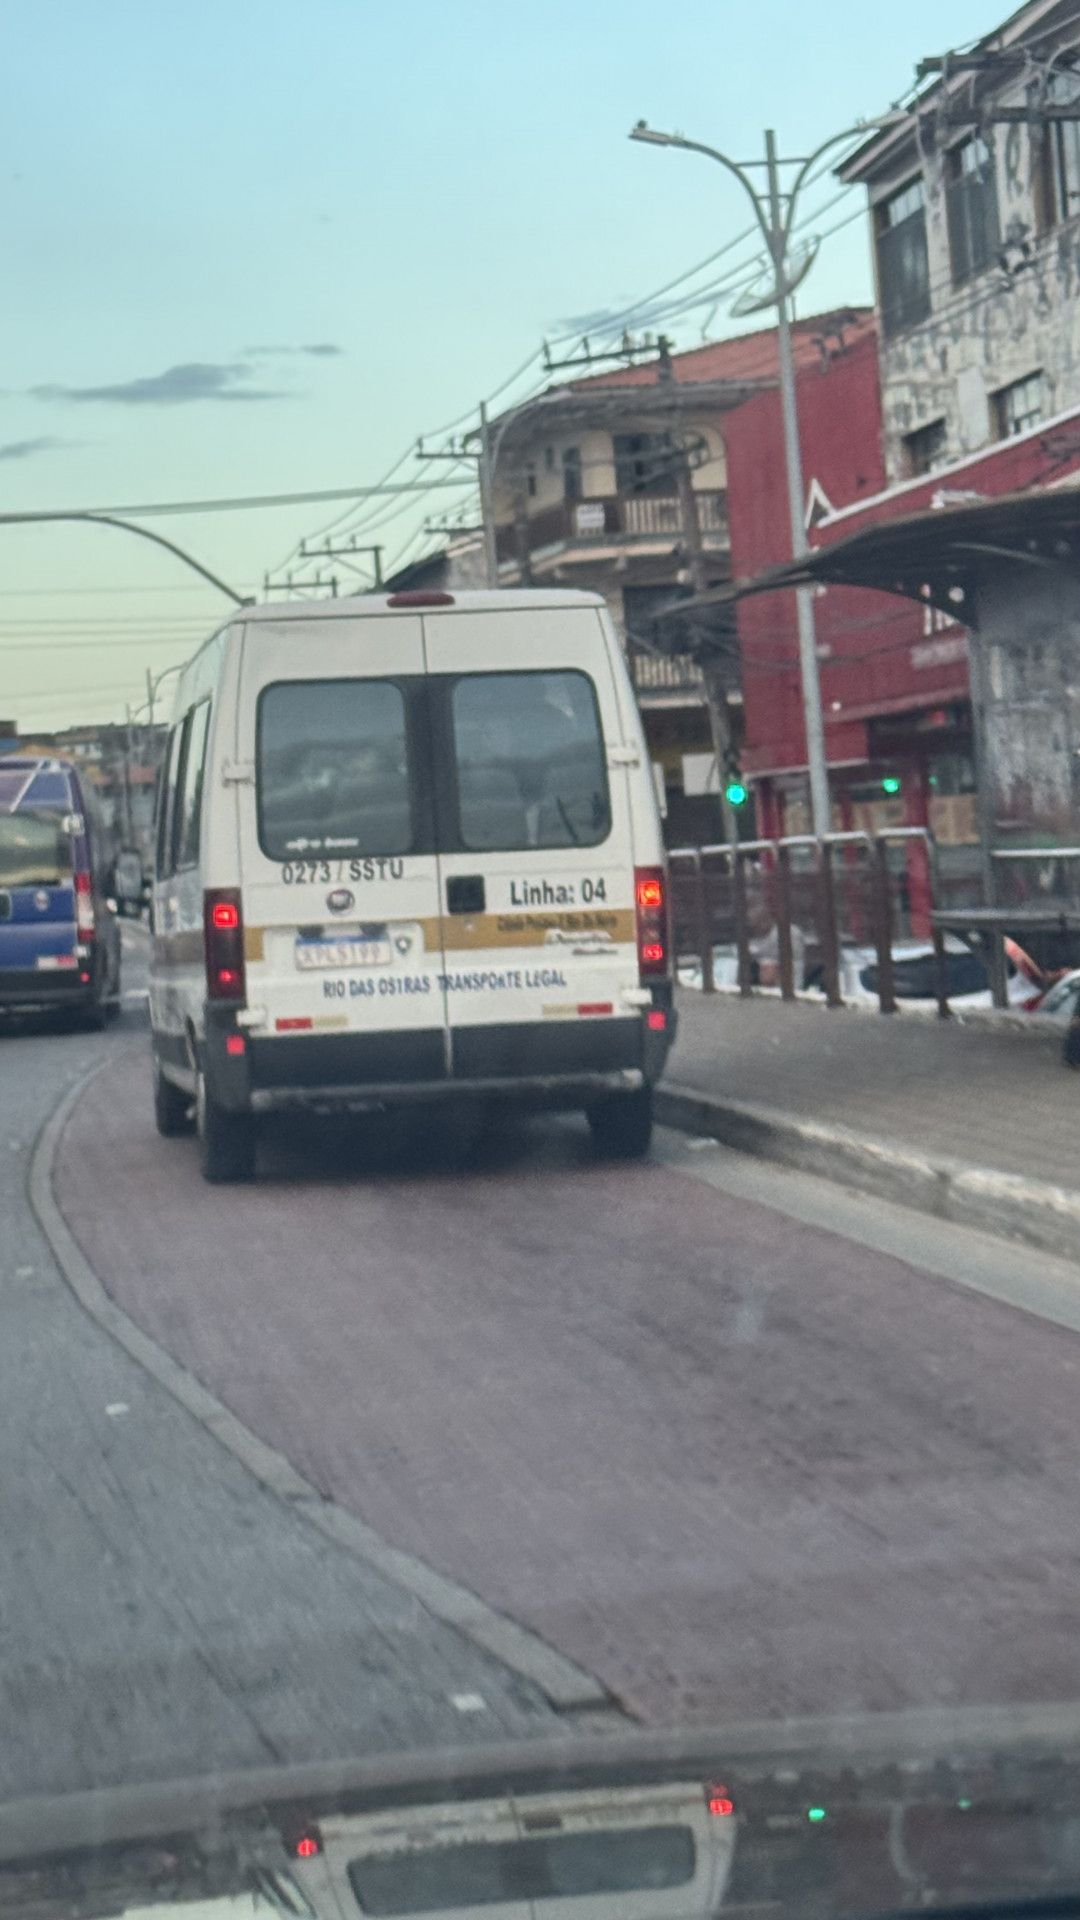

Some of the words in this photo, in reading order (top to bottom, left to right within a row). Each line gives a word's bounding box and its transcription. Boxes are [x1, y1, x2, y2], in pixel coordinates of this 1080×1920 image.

[282, 859, 331, 885] 0273
[349, 856, 404, 881] SSTU
[510, 878, 576, 906] Linha:
[581, 876, 607, 904] 04
[323, 980, 345, 998] RIO
[349, 978, 374, 997] DAS
[379, 975, 430, 996] OSTRAS
[436, 971, 522, 993] TRANSPORTE
[525, 969, 567, 989] LEGAL
